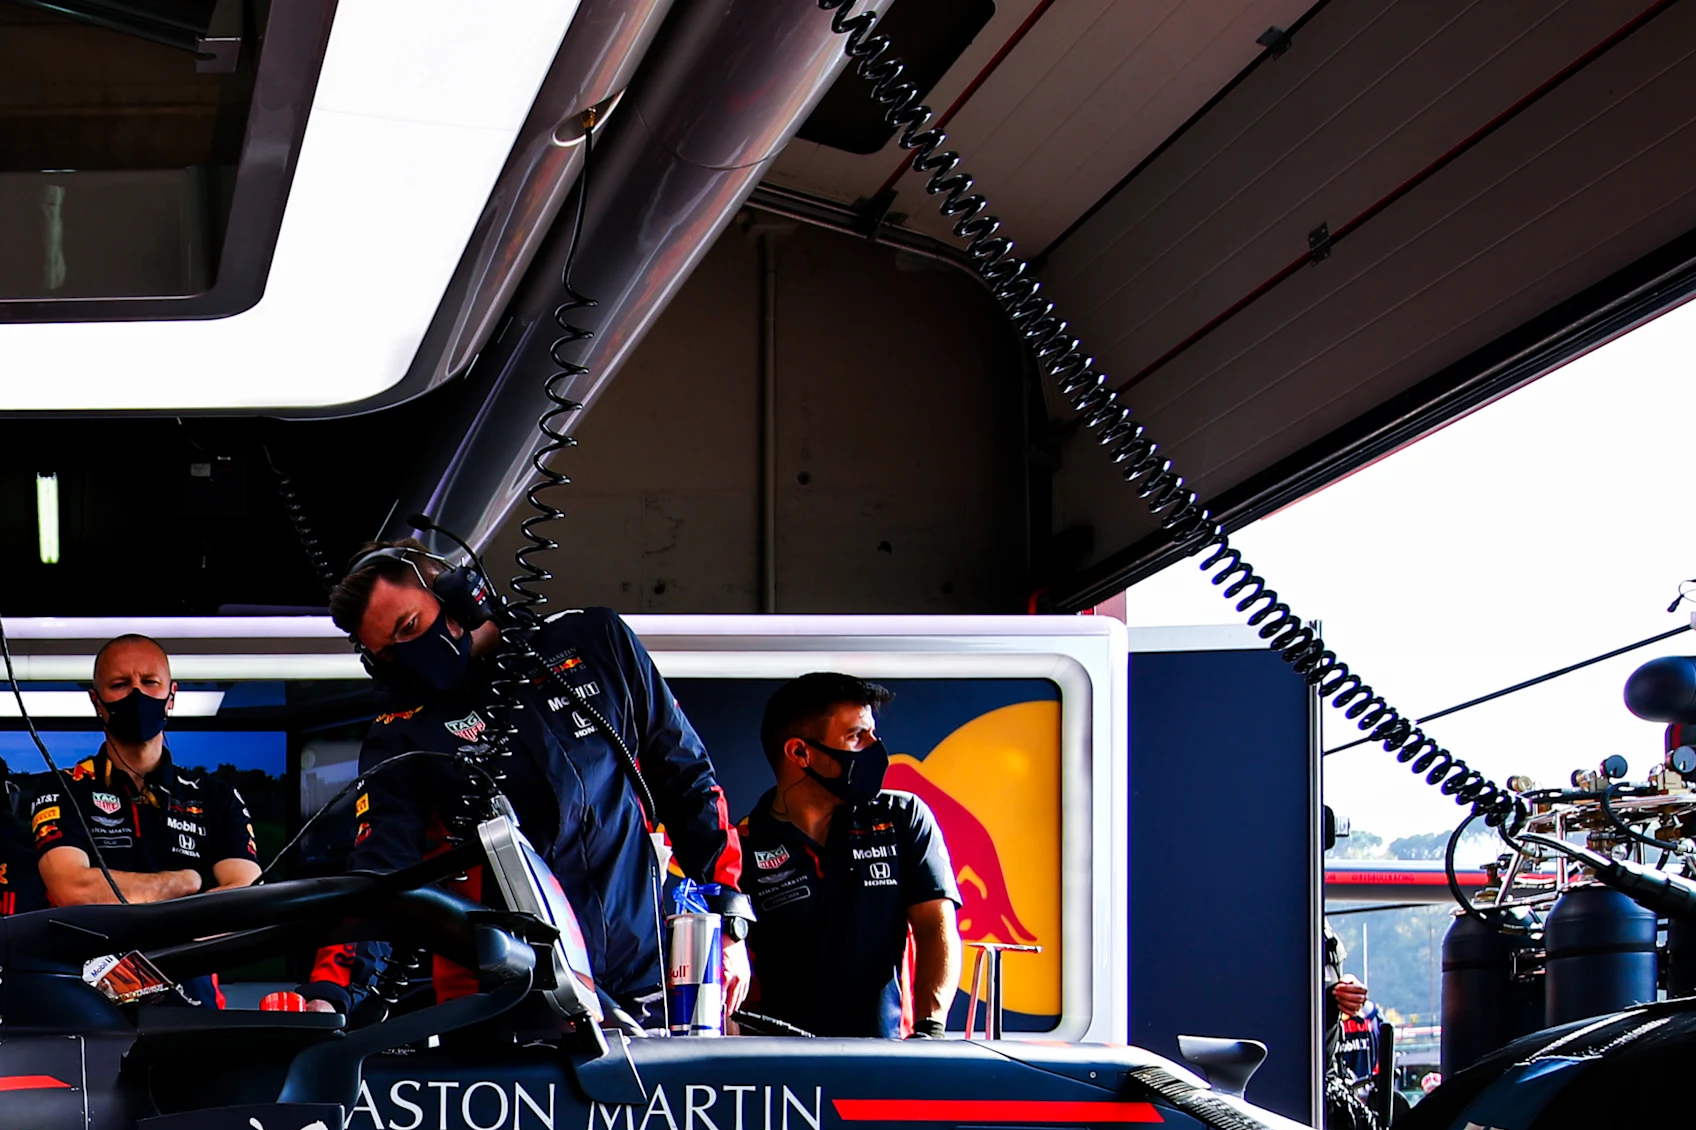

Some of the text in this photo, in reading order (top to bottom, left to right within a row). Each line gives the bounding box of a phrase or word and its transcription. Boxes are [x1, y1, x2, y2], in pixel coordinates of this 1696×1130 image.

[450, 713, 479, 731] TAG
[573, 726, 598, 738] HON
[167, 817, 196, 834] Mobil
[172, 847, 200, 858] HONDA
[757, 847, 784, 860] TAG
[853, 846, 887, 860] Mobil
[864, 879, 898, 887] HONDA
